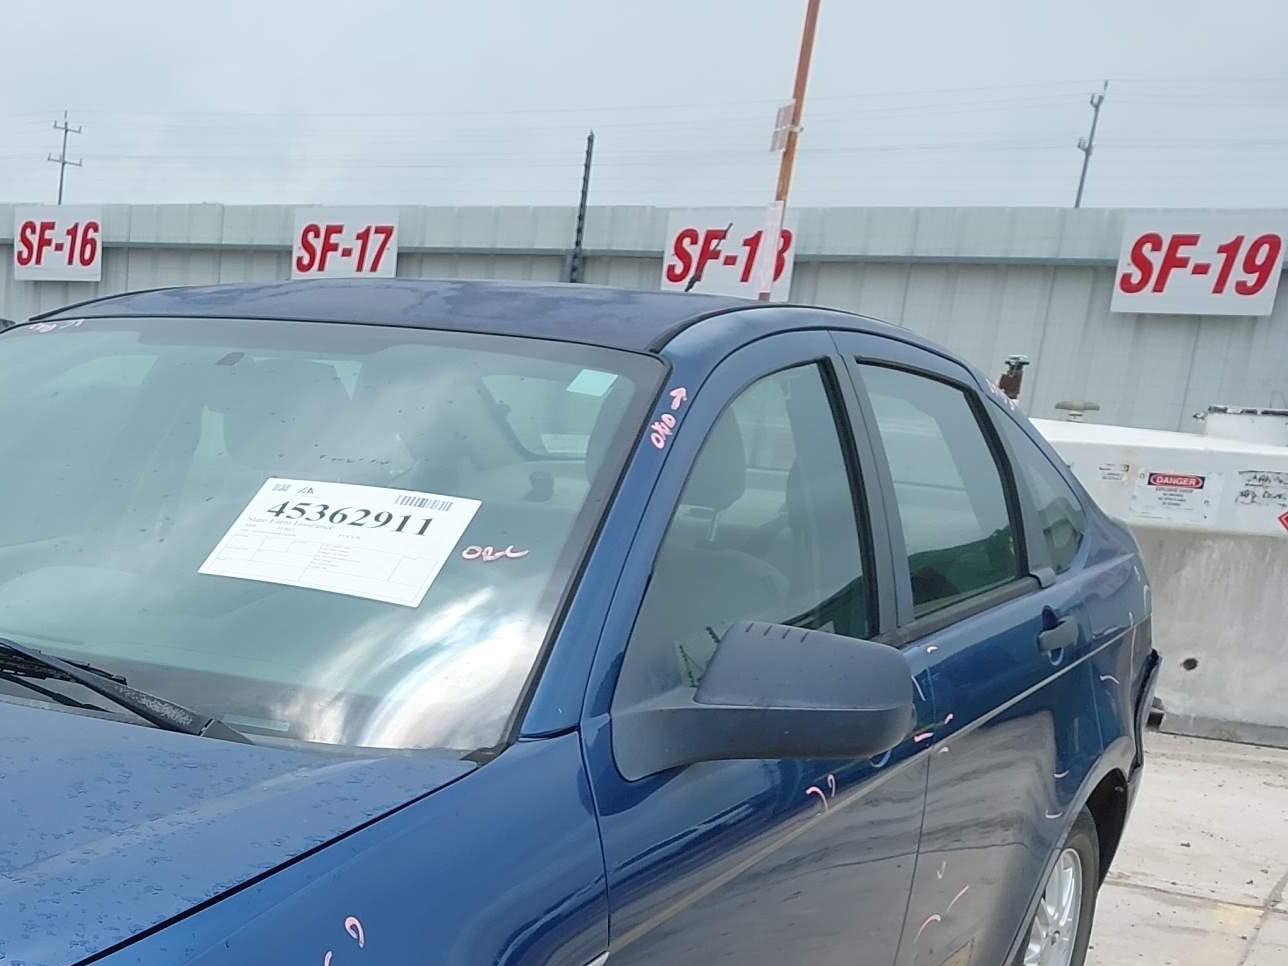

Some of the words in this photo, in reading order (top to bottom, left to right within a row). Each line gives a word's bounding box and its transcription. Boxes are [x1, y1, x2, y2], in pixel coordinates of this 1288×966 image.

[16, 220, 99, 267] SF-16
[295, 224, 394, 273] SF-17
[1119, 232, 1283, 296] SF-19
[1155, 476, 1198, 486] DANGER
[266, 500, 433, 536] 45362911
